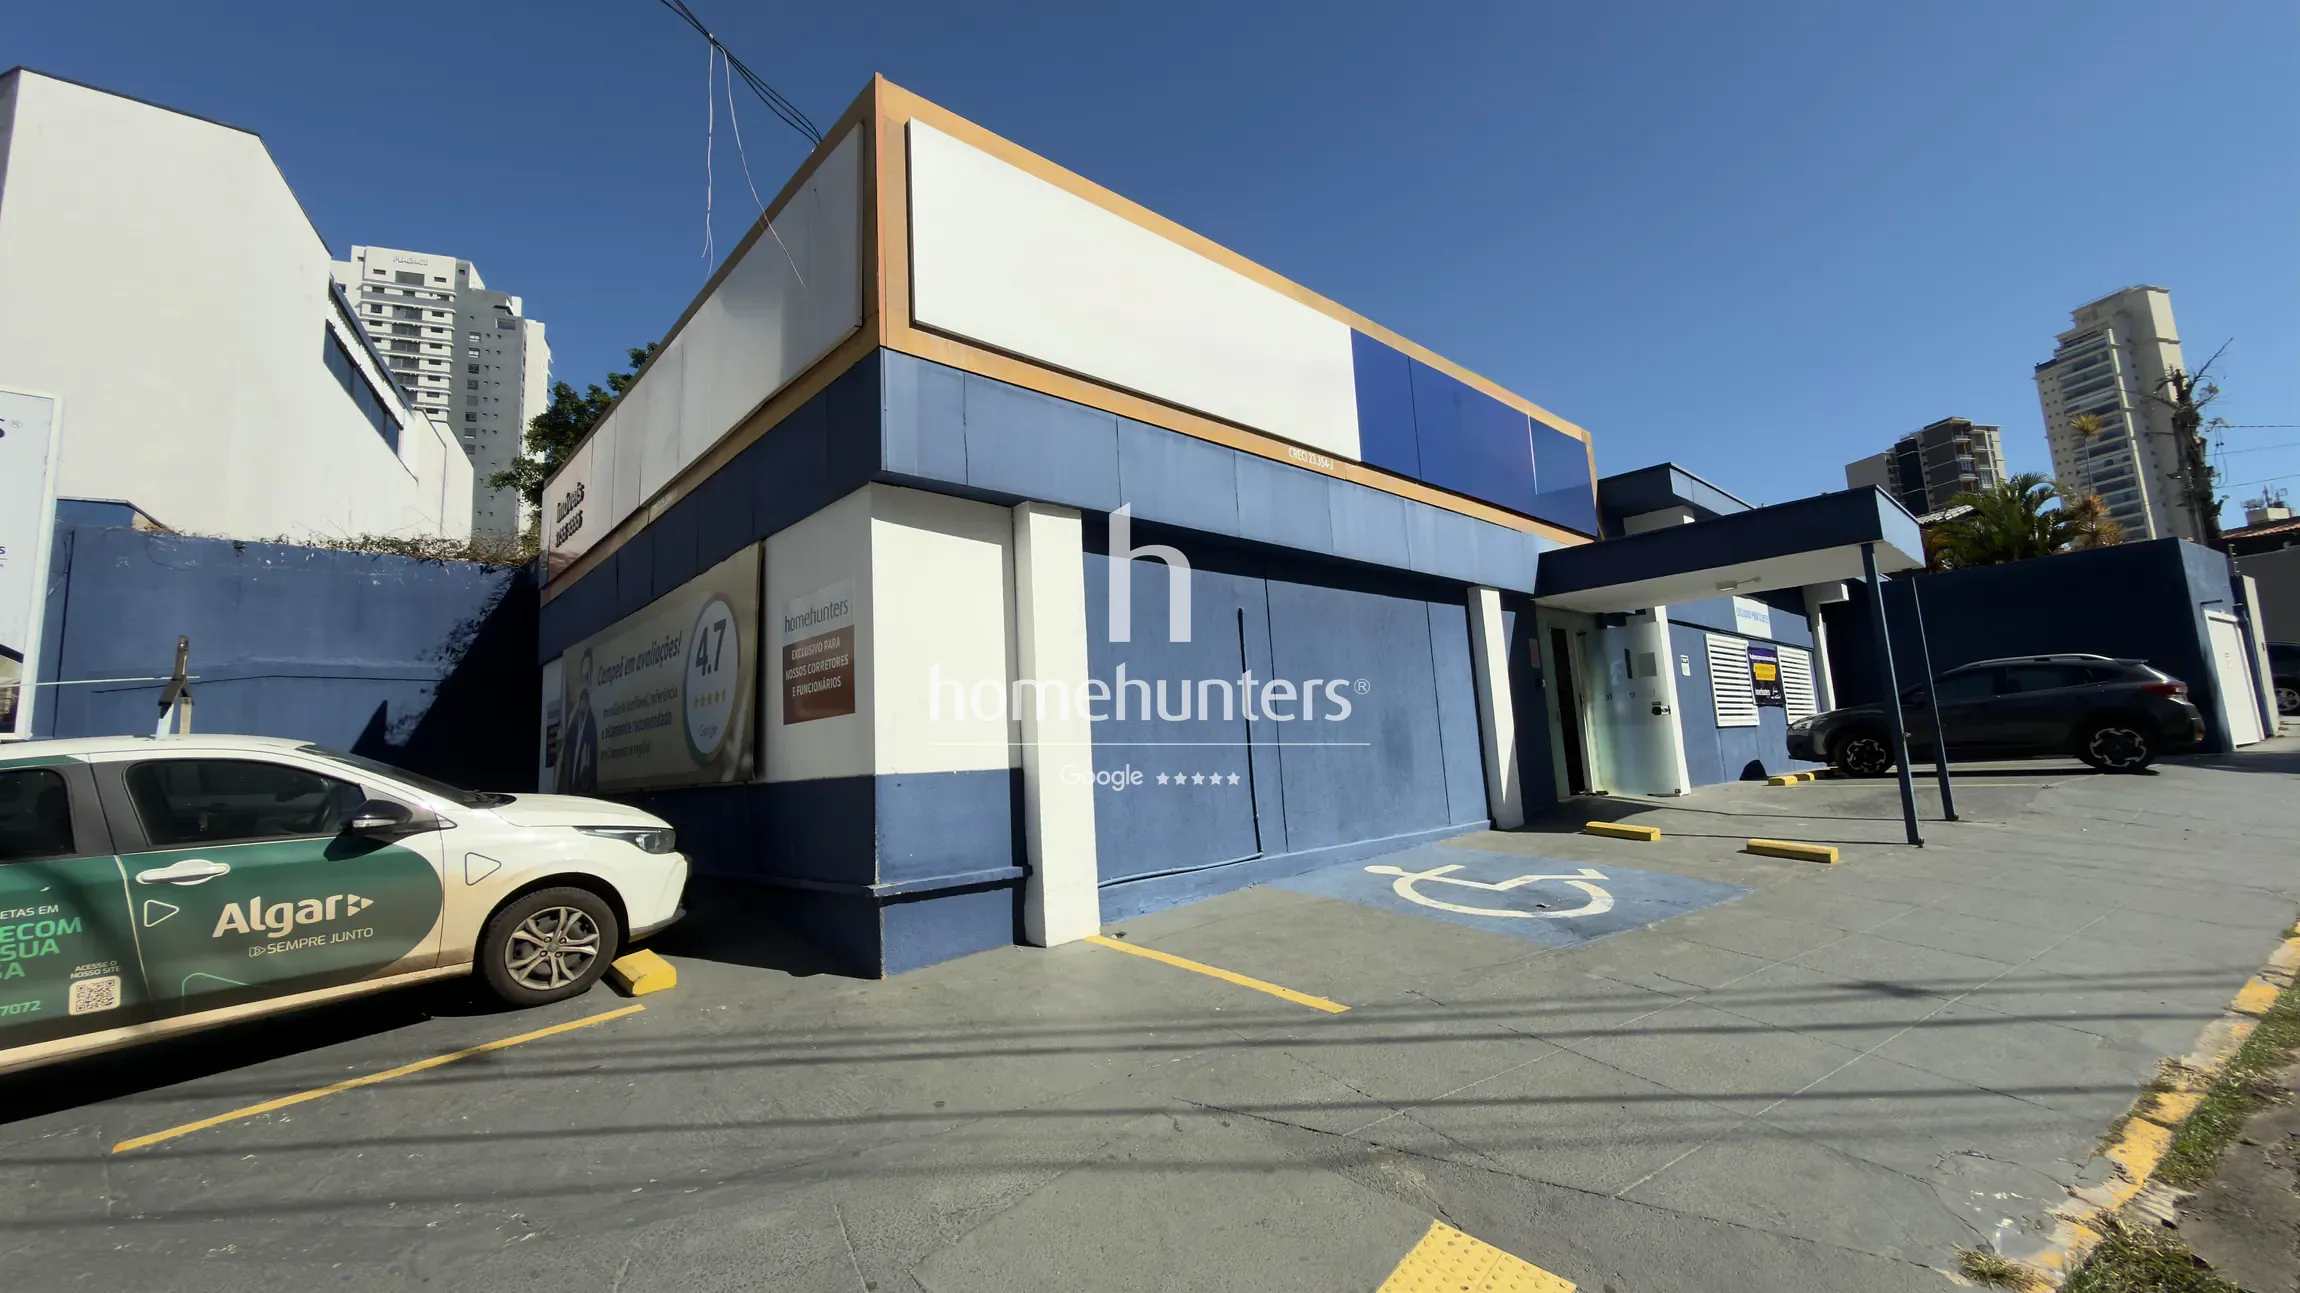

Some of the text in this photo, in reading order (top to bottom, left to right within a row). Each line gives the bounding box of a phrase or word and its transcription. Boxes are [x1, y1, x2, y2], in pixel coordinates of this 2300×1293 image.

[784, 599, 849, 634] homehunters
[695, 618, 727, 676] 4.7
[791, 636, 841, 660] EXCLUSIVO PARA
[625, 655, 636, 677] em
[785, 653, 849, 680] NOSSOS CORRETORES
[792, 675, 842, 697] E FUNCIONÁRIOS
[38, 904, 59, 915] EM
[212, 894, 343, 938] Algar
[0, 938, 60, 962] SUA
[267, 927, 374, 954] SEMPRE JUNTO
[0, 961, 25, 980] A
[70, 965, 121, 979] NOSSO SITE
[75, 961, 108, 972] ACESSE
